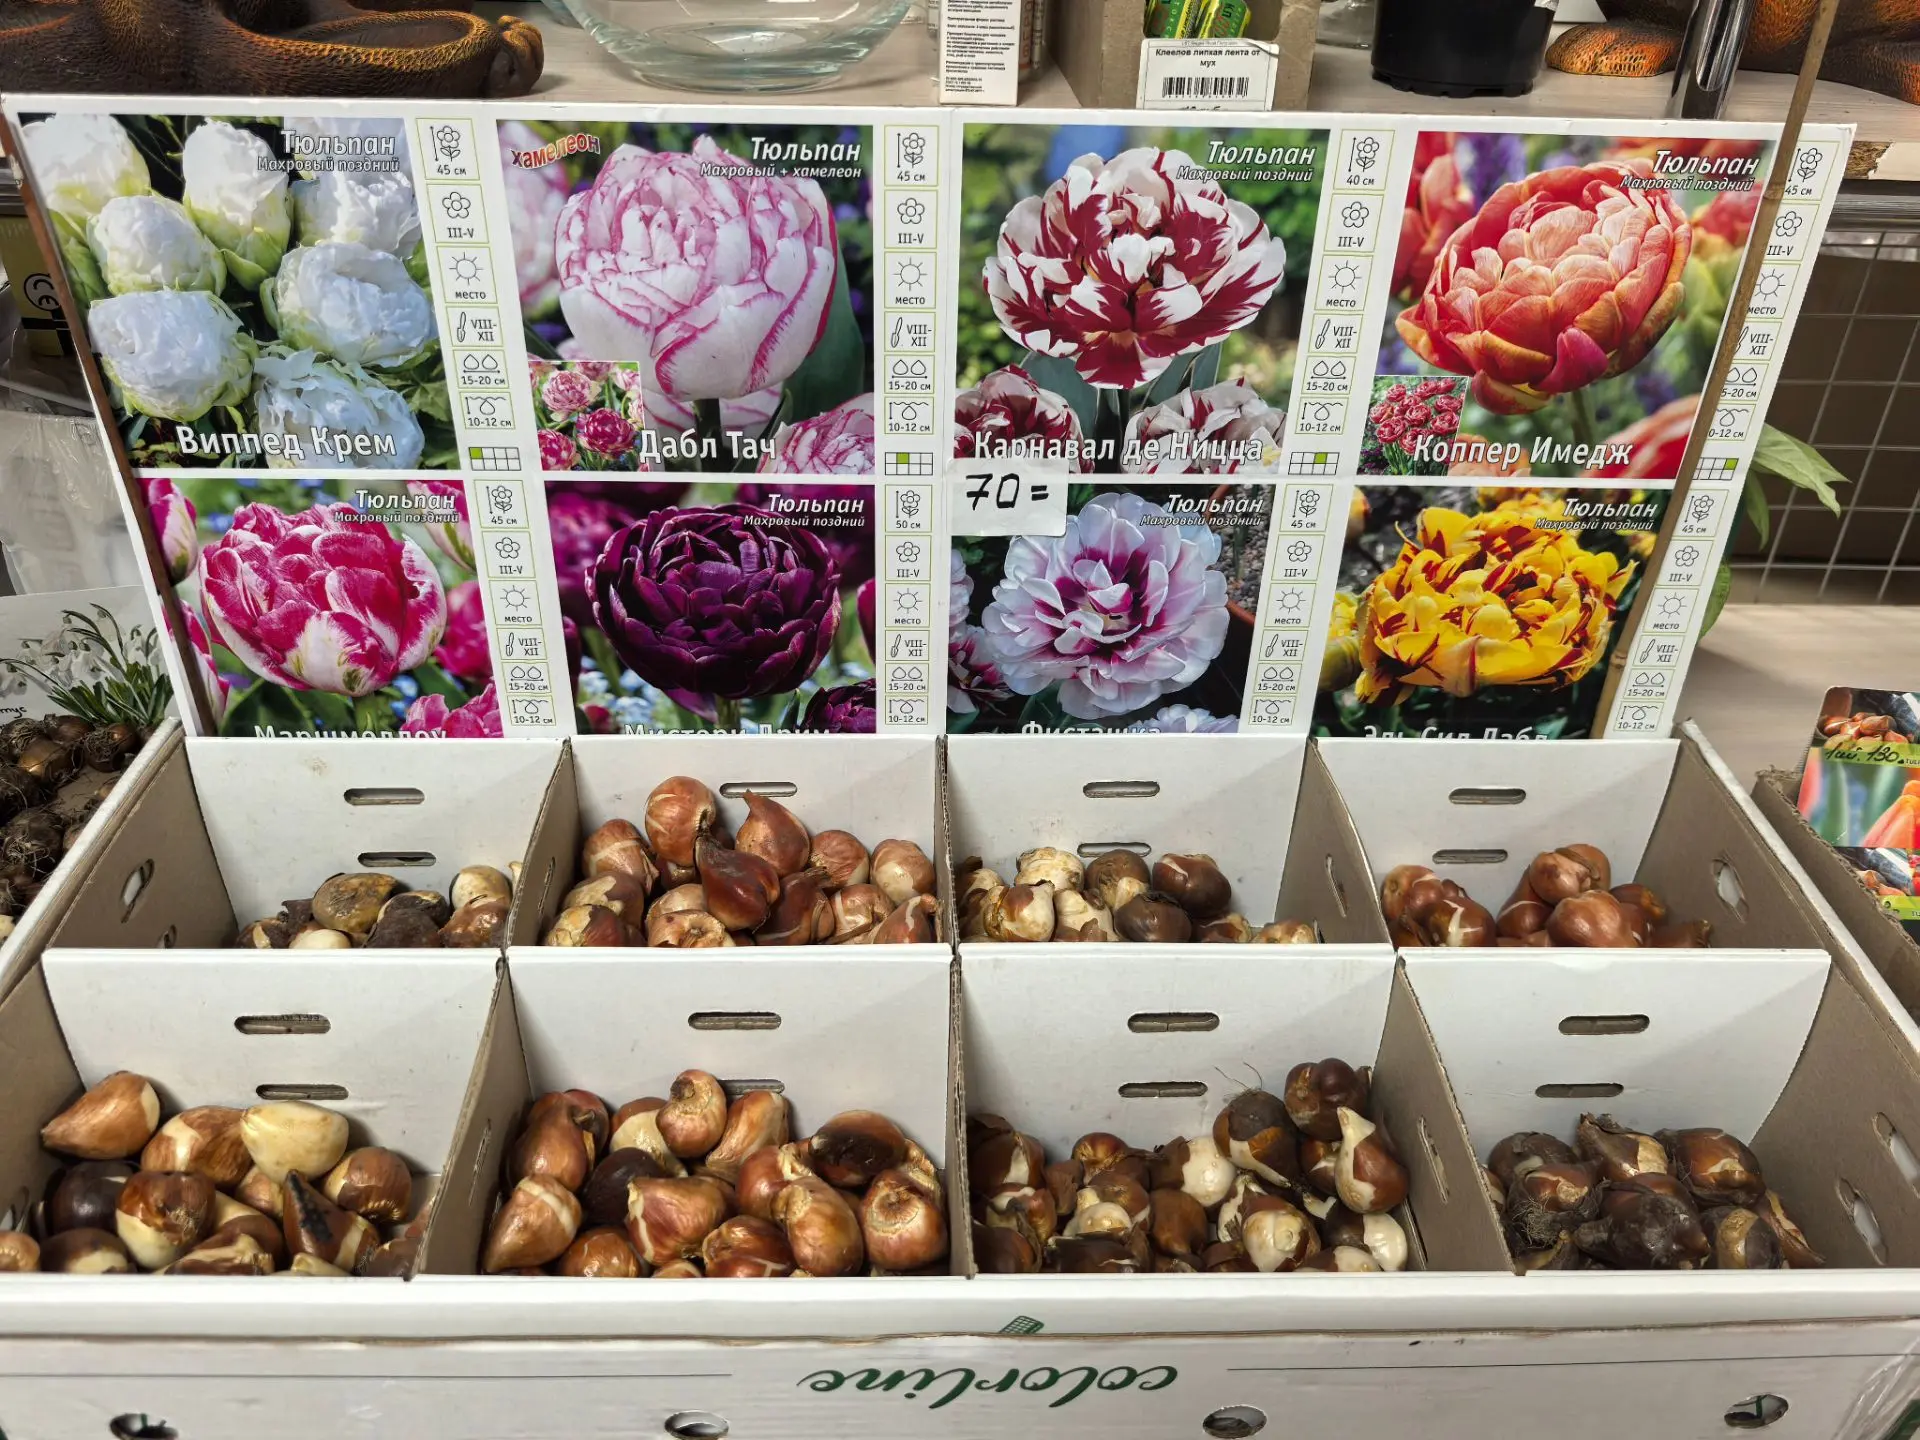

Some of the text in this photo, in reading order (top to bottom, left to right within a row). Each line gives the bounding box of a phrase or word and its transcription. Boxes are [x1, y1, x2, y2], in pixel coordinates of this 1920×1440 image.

[280, 130, 396, 155] Тюльпан
[750, 137, 861, 161] Тюльпан
[1207, 140, 1316, 165] Тюльпан
[258, 156, 400, 172] Махровый поздний
[1652, 150, 1760, 176] Тюльпан
[437, 165, 466, 175] 45 см
[700, 164, 775, 179] Махровый
[792, 166, 862, 179] хамелеон
[1176, 165, 1313, 183] Махровый поздний
[897, 171, 925, 182] 45 см
[1347, 175, 1375, 186] 40 см
[1620, 174, 1755, 192] Махровый поздний
[1785, 185, 1798, 195] 45
[447, 228, 474, 239] III-V
[898, 233, 924, 245] III-V
[1338, 237, 1364, 247] III-V
[1767, 246, 1793, 256] III-V
[456, 291, 486, 300] место
[896, 296, 925, 305] место
[1326, 299, 1356, 307] место
[1748, 306, 1777, 315] место
[471, 319, 497, 330] VIII-
[906, 324, 932, 335] VIII-
[478, 331, 494, 342] XII
[1333, 326, 1357, 337] VIII-
[911, 337, 927, 347] XII
[1335, 338, 1351, 349] XII
[1750, 334, 1774, 343] VIII-
[1750, 346, 1767, 355] XII
[461, 376, 491, 386] 15-20
[889, 381, 917, 390] 15-20
[1307, 382, 1348, 391] 15-20 см
[1721, 389, 1744, 397] 5-20
[468, 417, 511, 427] 10-12 см
[889, 423, 916, 432] 10-12
[1299, 423, 1328, 432] 10-12
[1709, 429, 1731, 437] 0-12
[175, 424, 397, 462] Виппед Крем
[639, 429, 776, 463] Дабл Тач
[974, 430, 1263, 466] Карнавал де Ницца
[1413, 434, 1633, 471] Коппер Имедж
[356, 490, 456, 510] Тюльпан
[768, 493, 864, 513] Тюльпан
[1166, 494, 1263, 513] Тюльпан
[1562, 498, 1657, 518] Тюльпан
[334, 511, 459, 523] Махровый поздний
[491, 516, 503, 524] 45
[743, 514, 865, 528] Махровый поздний
[1139, 514, 1261, 528] Махровый поздний
[896, 520, 907, 528] 50
[1291, 520, 1303, 528] 45
[1534, 517, 1654, 532] Махровый поздний
[1682, 525, 1693, 533] 45
[499, 566, 522, 574] III-V
[897, 569, 919, 577] III-V
[1284, 569, 1307, 577] III-V
[1669, 574, 1693, 582] III-V
[518, 638, 542, 646] VIII-
[905, 640, 926, 648] VIII-
[1281, 640, 1303, 648] VIII-
[908, 649, 922, 657] XII
[1283, 649, 1297, 657] XII
[1656, 645, 1679, 653] VIII-
[1657, 654, 1672, 662] XII
[888, 683, 913, 691] 15-20
[1258, 683, 1283, 691] 15-20
[1627, 689, 1653, 697] 15-20
[797, 1366, 1178, 1409] colorline
